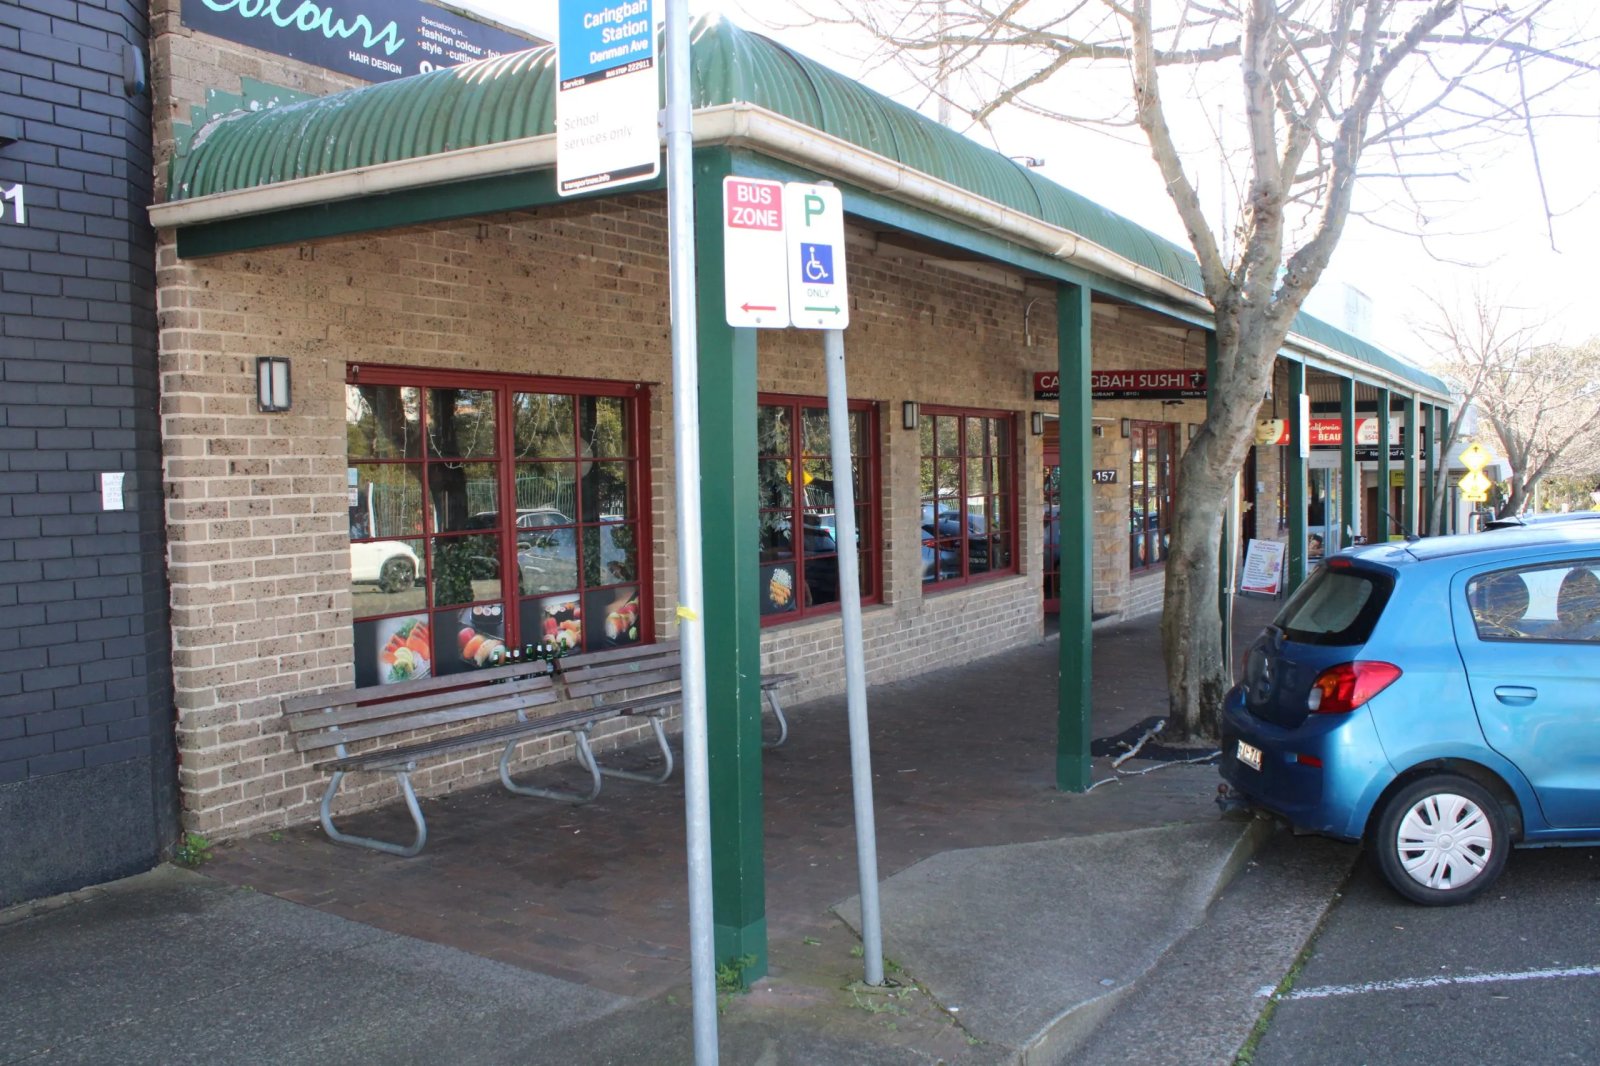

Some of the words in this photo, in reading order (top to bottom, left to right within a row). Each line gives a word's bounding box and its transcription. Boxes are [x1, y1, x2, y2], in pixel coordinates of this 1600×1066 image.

[584, 0, 648, 29] Caringbah
[199, 0, 405, 55] olours
[602, 19, 648, 44] Station
[421, 26, 454, 46] fashion
[455, 39, 482, 55] colour
[421, 41, 443, 55] style
[449, 50, 479, 63] cuttin
[589, 45, 630, 64] Denman
[630, 38, 648, 53] Ave
[349, 51, 370, 65] HAIR
[371, 57, 402, 75] DESIGN
[616, 66, 628, 75] STOP
[562, 78, 585, 90] Services
[564, 112, 600, 131] School
[564, 132, 608, 151] services
[609, 125, 633, 141] only
[737, 184, 772, 204] BUS
[732, 207, 778, 227] ZONE
[804, 194, 825, 227] P
[807, 288, 830, 298] ONLY
[1139, 374, 1184, 387] SUSHI
[1310, 422, 1340, 433] alifornia
[1318, 433, 1341, 441] BEAU
[1096, 471, 1115, 481] 157
